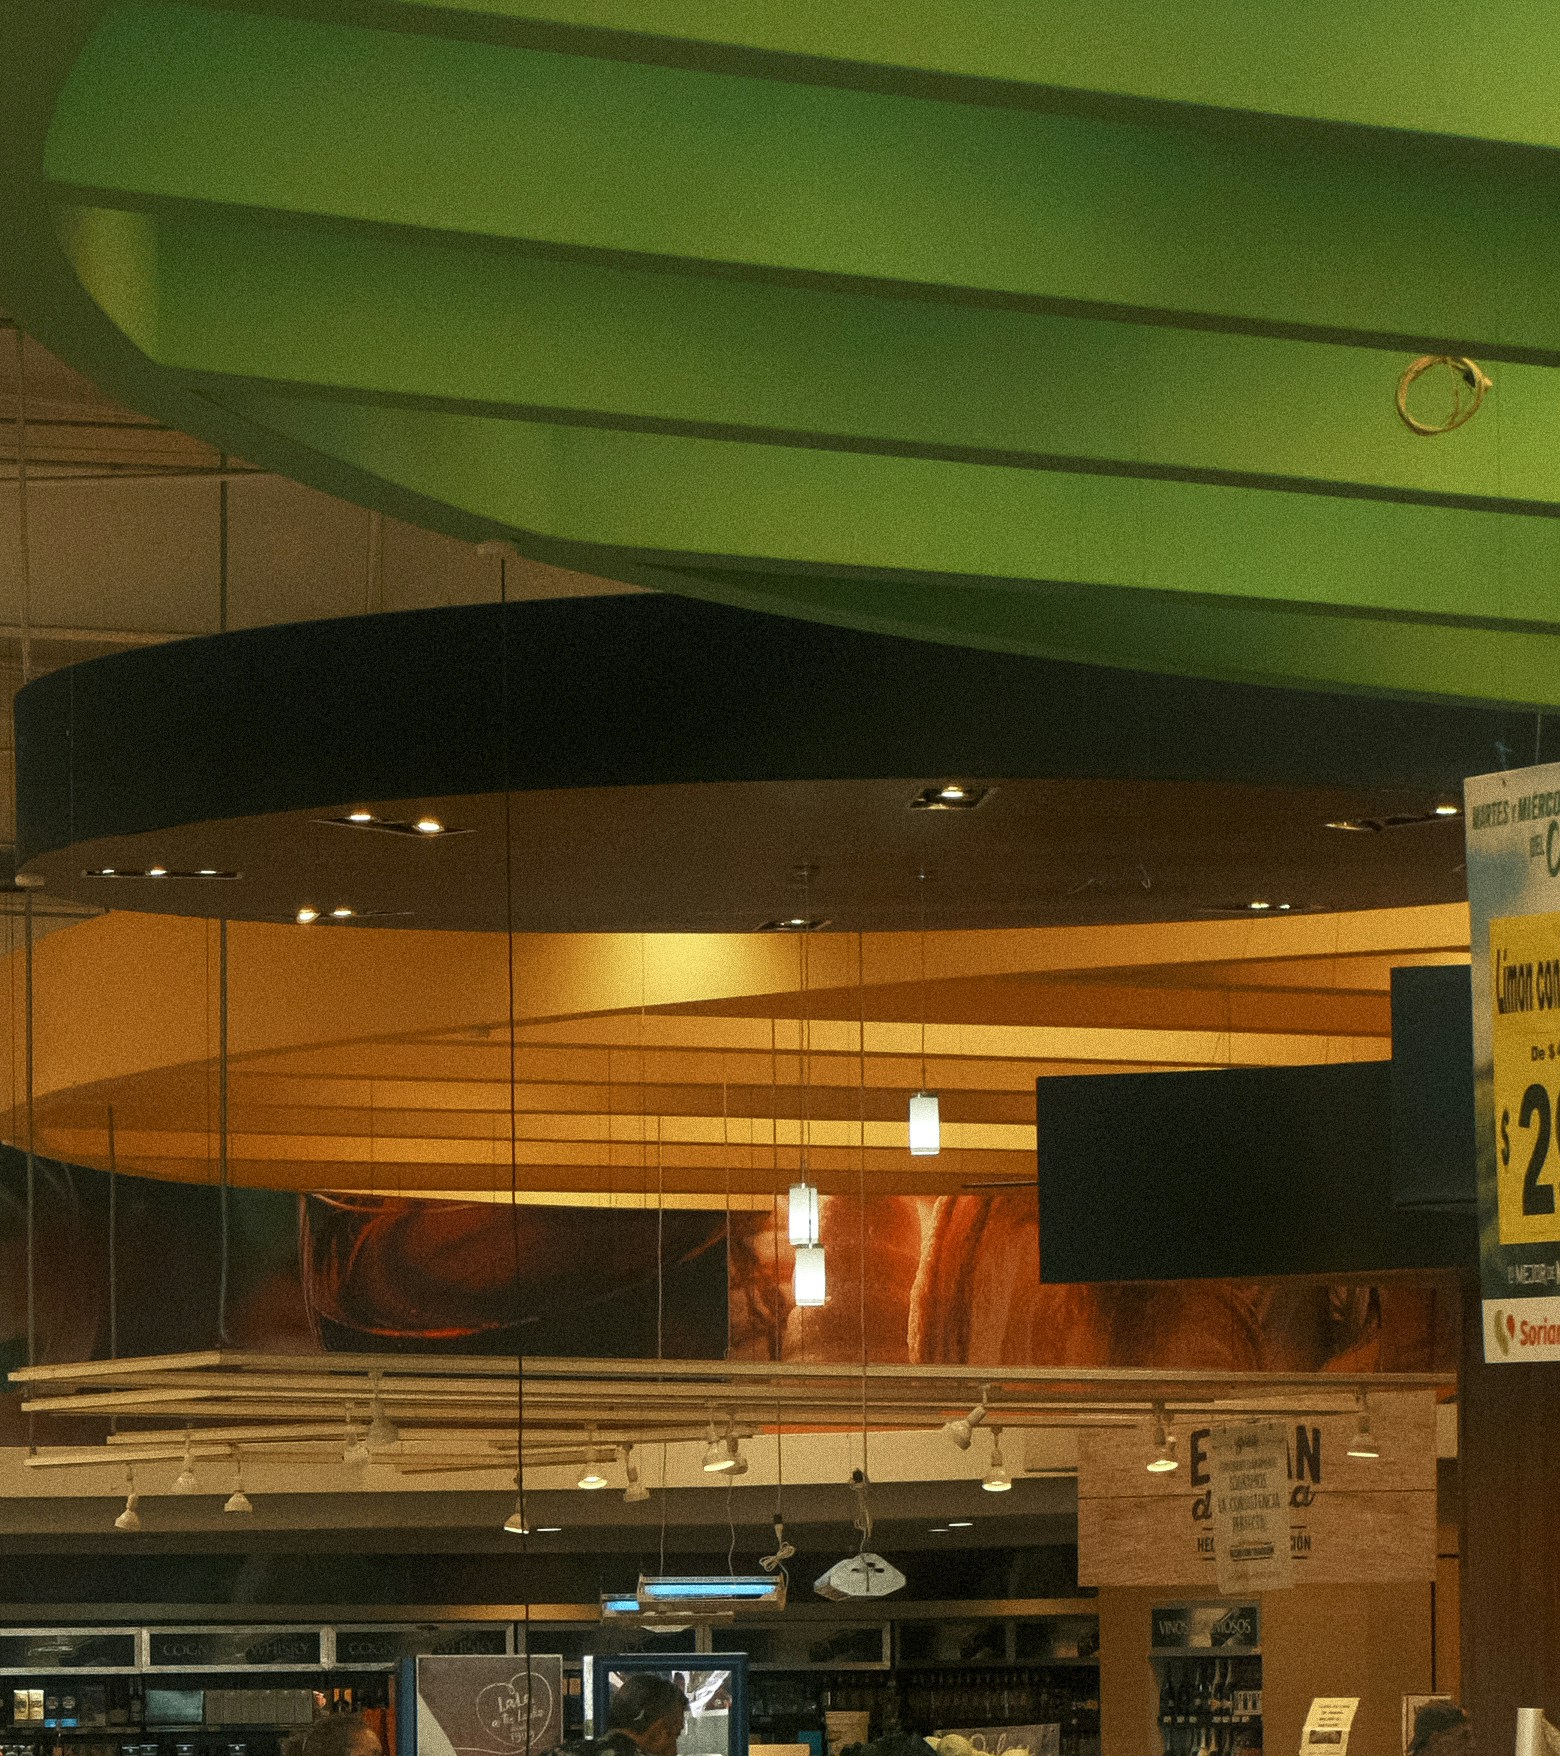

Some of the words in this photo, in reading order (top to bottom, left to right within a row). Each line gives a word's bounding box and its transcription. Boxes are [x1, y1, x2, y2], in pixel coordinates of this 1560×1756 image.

[1472, 800, 1509, 830] MARTES
[1531, 1045, 1545, 1061] De
[1501, 1106, 1511, 1173] $
